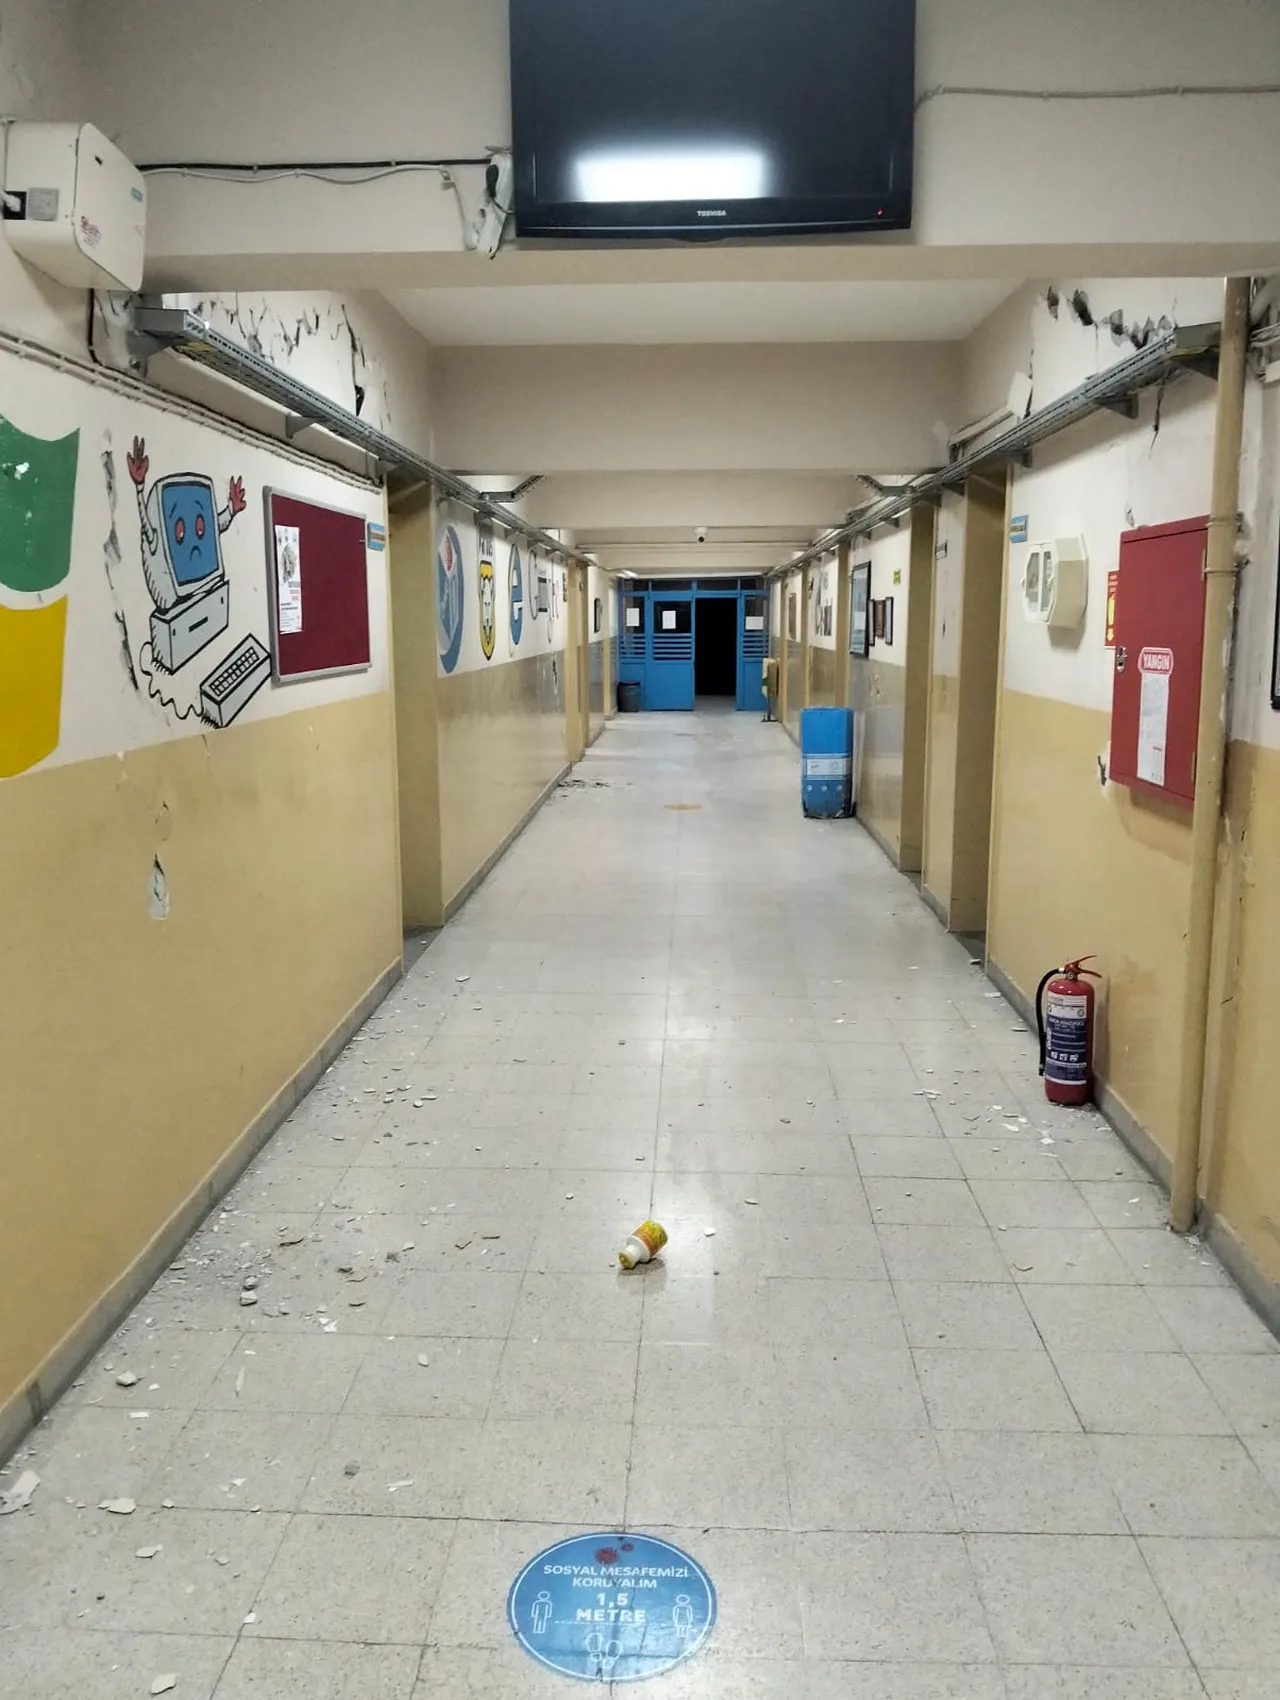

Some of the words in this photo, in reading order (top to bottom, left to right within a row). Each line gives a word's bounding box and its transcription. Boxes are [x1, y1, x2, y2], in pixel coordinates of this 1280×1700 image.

[1143, 654, 1170, 670] YANGIN
[543, 1564, 597, 1576] SOSYAL
[600, 1565, 688, 1578] MESAFEMİZİ
[572, 1577, 658, 1589] KORUYALIM
[596, 1592, 629, 1608] 1,5
[576, 1608, 646, 1623] METRE
